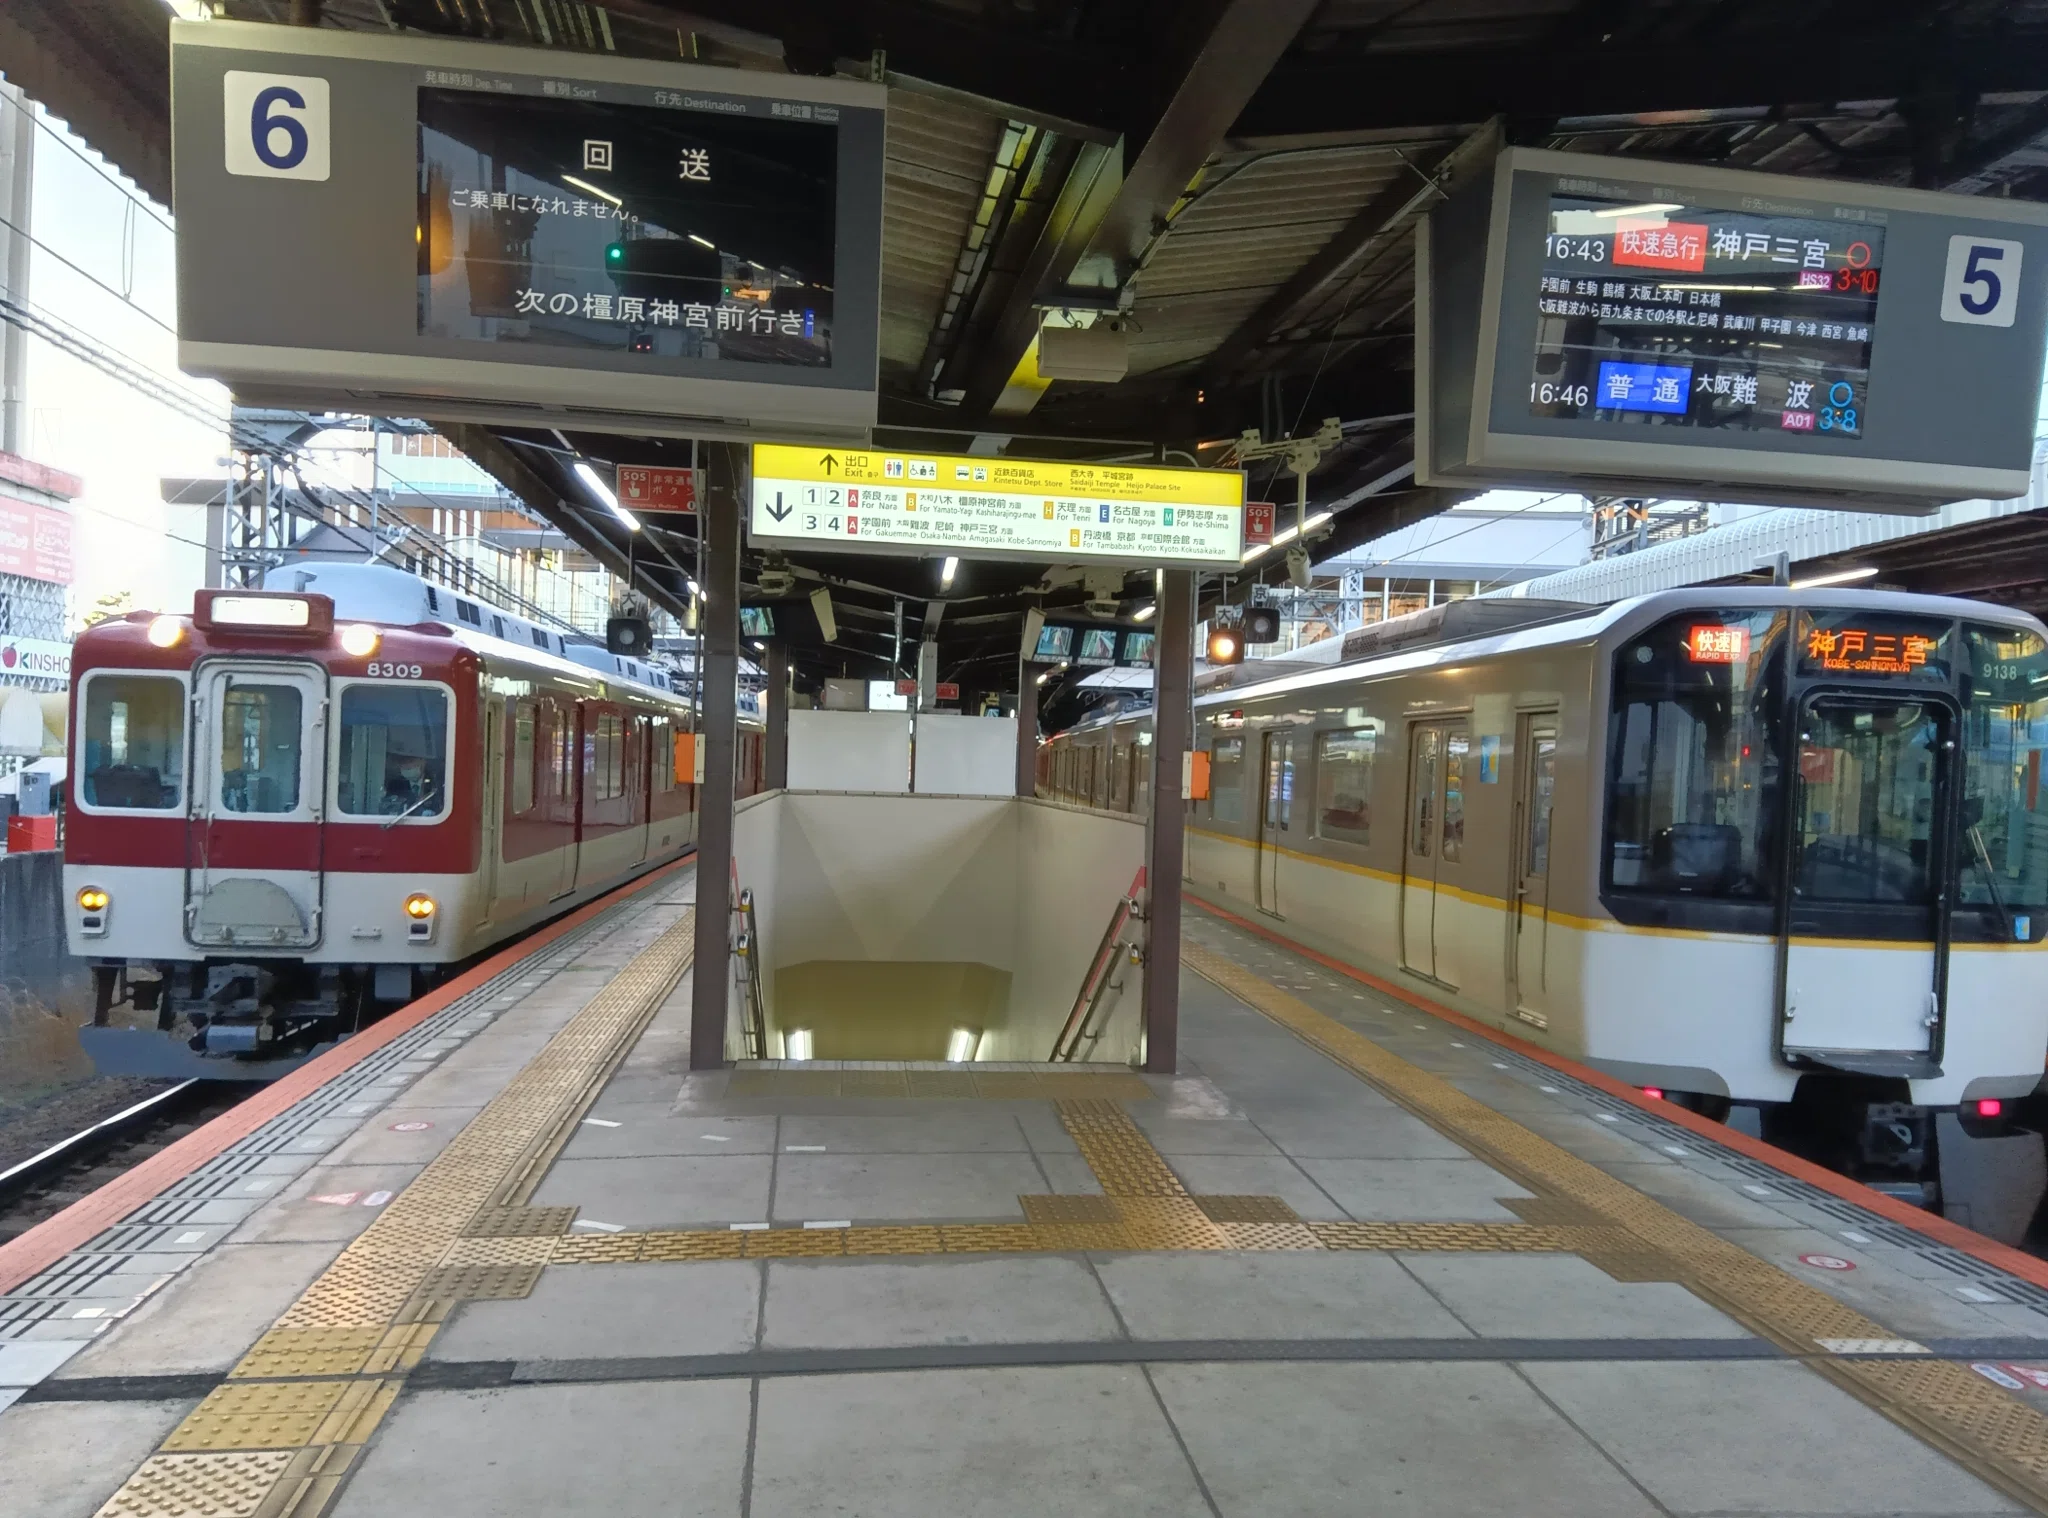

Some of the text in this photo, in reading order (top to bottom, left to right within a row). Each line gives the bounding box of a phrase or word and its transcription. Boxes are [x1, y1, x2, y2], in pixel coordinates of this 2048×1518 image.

[425, 70, 473, 87] 発車時刻
[542, 80, 598, 99] 種別 Sort
[654, 90, 747, 113] 行先 Destination
[250, 85, 310, 170] 6
[451, 188, 640, 224] ご乗車になれません。
[1764, 202, 1814, 216] Destination
[1545, 235, 1605, 262] 16:43
[1621, 229, 1699, 261] 快速急行
[1711, 228, 1831, 269] 神戸三宮
[1802, 272, 1830, 289] HS32
[1958, 243, 2004, 316] 5
[1575, 280, 1598, 297] 生駒
[1602, 283, 1626, 300] 鶴橋
[1629, 285, 1684, 305] 大阪上本町
[1689, 292, 1722, 308] 日本橋
[514, 287, 805, 336] 次の橿原神宮前行き
[1722, 314, 1755, 332] 武庫川
[1760, 317, 1792, 335] 甲子園
[1796, 321, 1818, 338] 今津
[1821, 324, 1843, 340] 西宮
[1847, 327, 1869, 342] 魚崎
[1530, 382, 1589, 407] 16:46
[1606, 373, 1680, 404] 普通
[1784, 413, 1812, 429] A01
[845, 455, 868, 467] 出口
[623, 471, 646, 481] SOS
[844, 467, 863, 478] Exit
[994, 467, 1035, 478] 近鉄百貨店
[1070, 469, 1134, 481] 西大寺 平城宮跡
[993, 476, 1022, 485] Kintetsu
[1044, 480, 1063, 488] Store
[1070, 478, 1094, 487] Saidaiji
[1095, 480, 1120, 489] Temple
[1145, 482, 1167, 490] Palace
[807, 488, 840, 505] 1 2
[849, 494, 857, 503] A
[861, 490, 882, 501] 奈良
[908, 497, 915, 506] B
[861, 501, 898, 511] For Nara
[919, 504, 930, 512] For
[933, 505, 973, 517] Yamato-Yagi
[1045, 506, 1052, 514] H
[1057, 502, 1077, 513] 天理
[1113, 505, 1141, 516] 名古屋
[1056, 513, 1091, 522] For Tenri
[1101, 509, 1107, 518] E
[1165, 512, 1173, 522] M
[1177, 509, 1214, 520] 伊勢志摩
[1248, 508, 1270, 518] SOS
[806, 515, 840, 531] 3 4
[848, 520, 857, 530] A
[861, 517, 891, 529] 学園前
[934, 520, 954, 532] 尼崎
[960, 522, 998, 535] 神戸三宮
[1112, 516, 1156, 527] For Nagoya
[1176, 519, 1229, 530] For Ise-Shima
[860, 528, 1062, 548] For Gakuemmae Osaka-Namba Amagasaki Kobe-Sannomiya
[1071, 534, 1078, 543] B
[1083, 529, 1112, 541] 丹波橋
[1116, 531, 1136, 542] 京都
[1082, 540, 1094, 548] For
[1096, 541, 1135, 551] Tambabashi
[1137, 543, 1157, 553] Kyoto
[622, 592, 636, 606] 大
[1254, 586, 1267, 599] 京
[1217, 608, 1231, 621] 大
[1808, 629, 1929, 665] 神戸三宮
[1695, 651, 1720, 660] RAPID
[19, 651, 72, 674] KINSHO
[1823, 658, 1911, 673] KOBE-SANNOMIYA
[367, 662, 423, 679] 8309
[1983, 662, 2018, 681] 9138
